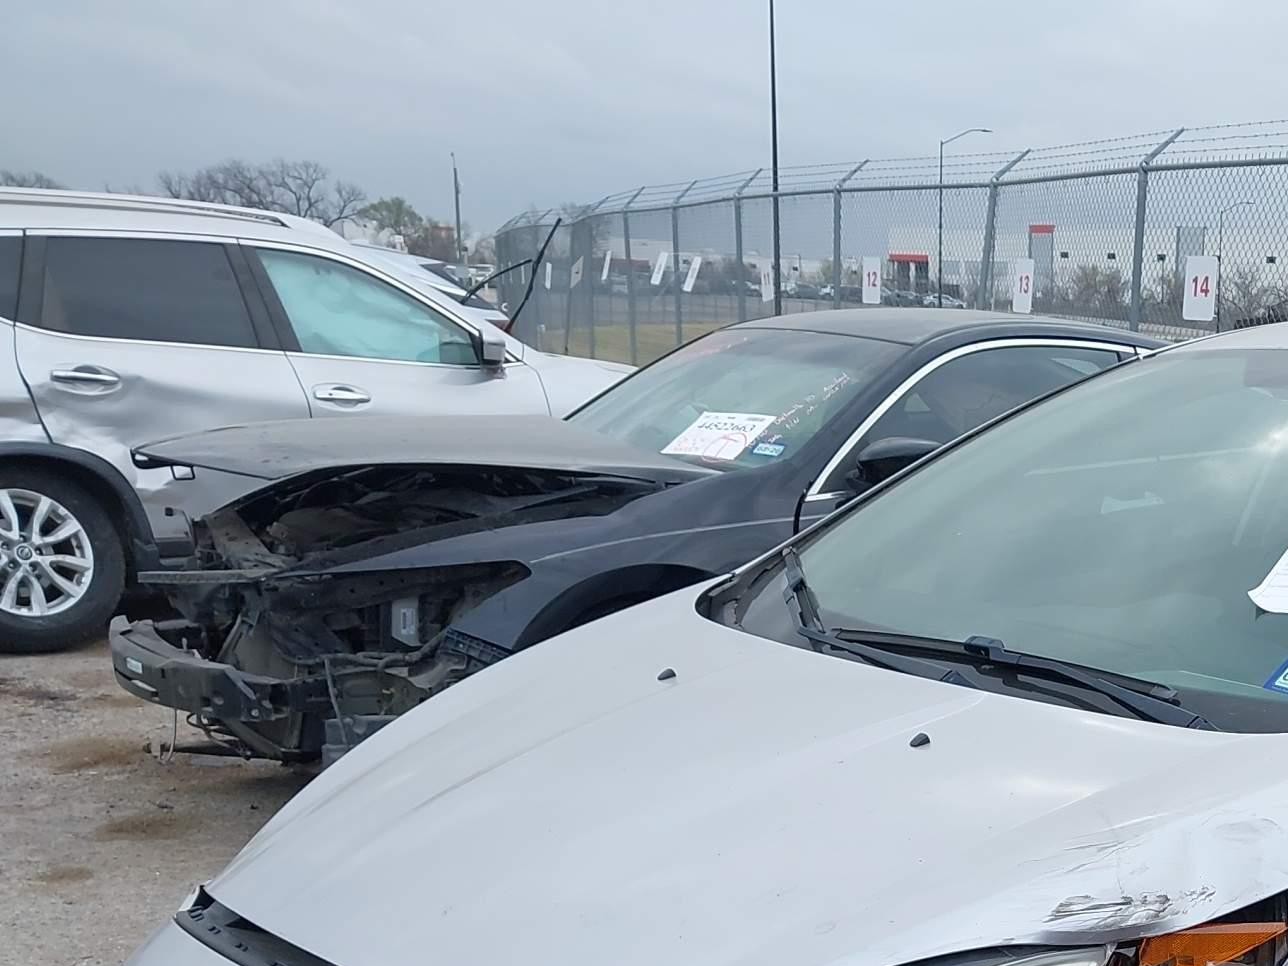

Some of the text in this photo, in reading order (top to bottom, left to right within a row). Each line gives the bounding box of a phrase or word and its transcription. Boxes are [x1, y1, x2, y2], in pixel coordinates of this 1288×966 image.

[866, 272, 878, 288] 12
[1018, 274, 1031, 294] 13
[1191, 275, 1211, 298] 14
